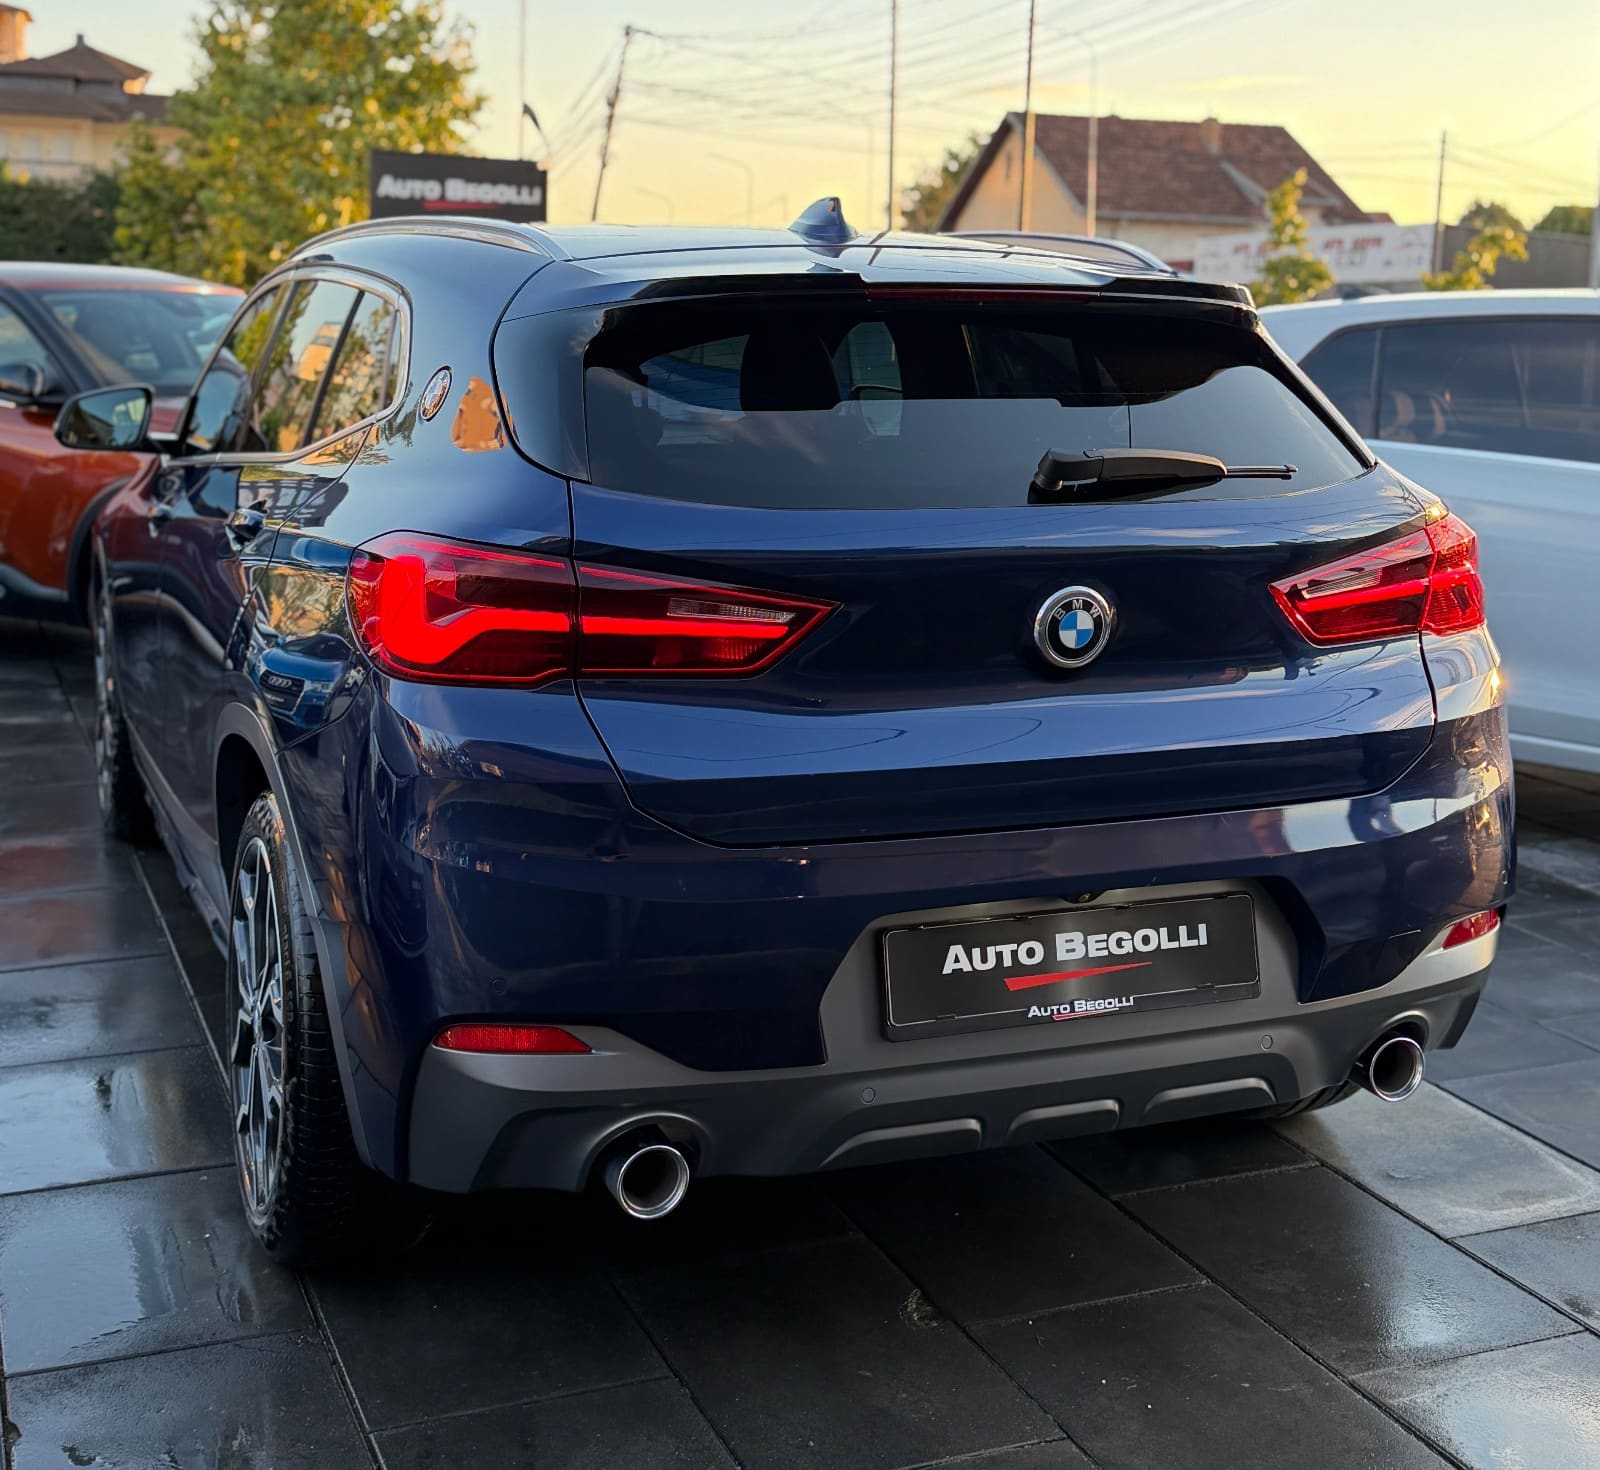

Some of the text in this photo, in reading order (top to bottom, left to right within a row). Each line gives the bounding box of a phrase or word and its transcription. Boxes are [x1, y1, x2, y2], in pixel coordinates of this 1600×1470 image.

[376, 173, 542, 205] AUTO BEGOLLI
[1053, 599, 1100, 621] BMW
[942, 923, 1208, 975] AUTO BEGOLLI
[1027, 996, 1134, 1018] AUTO BEGOLLI
